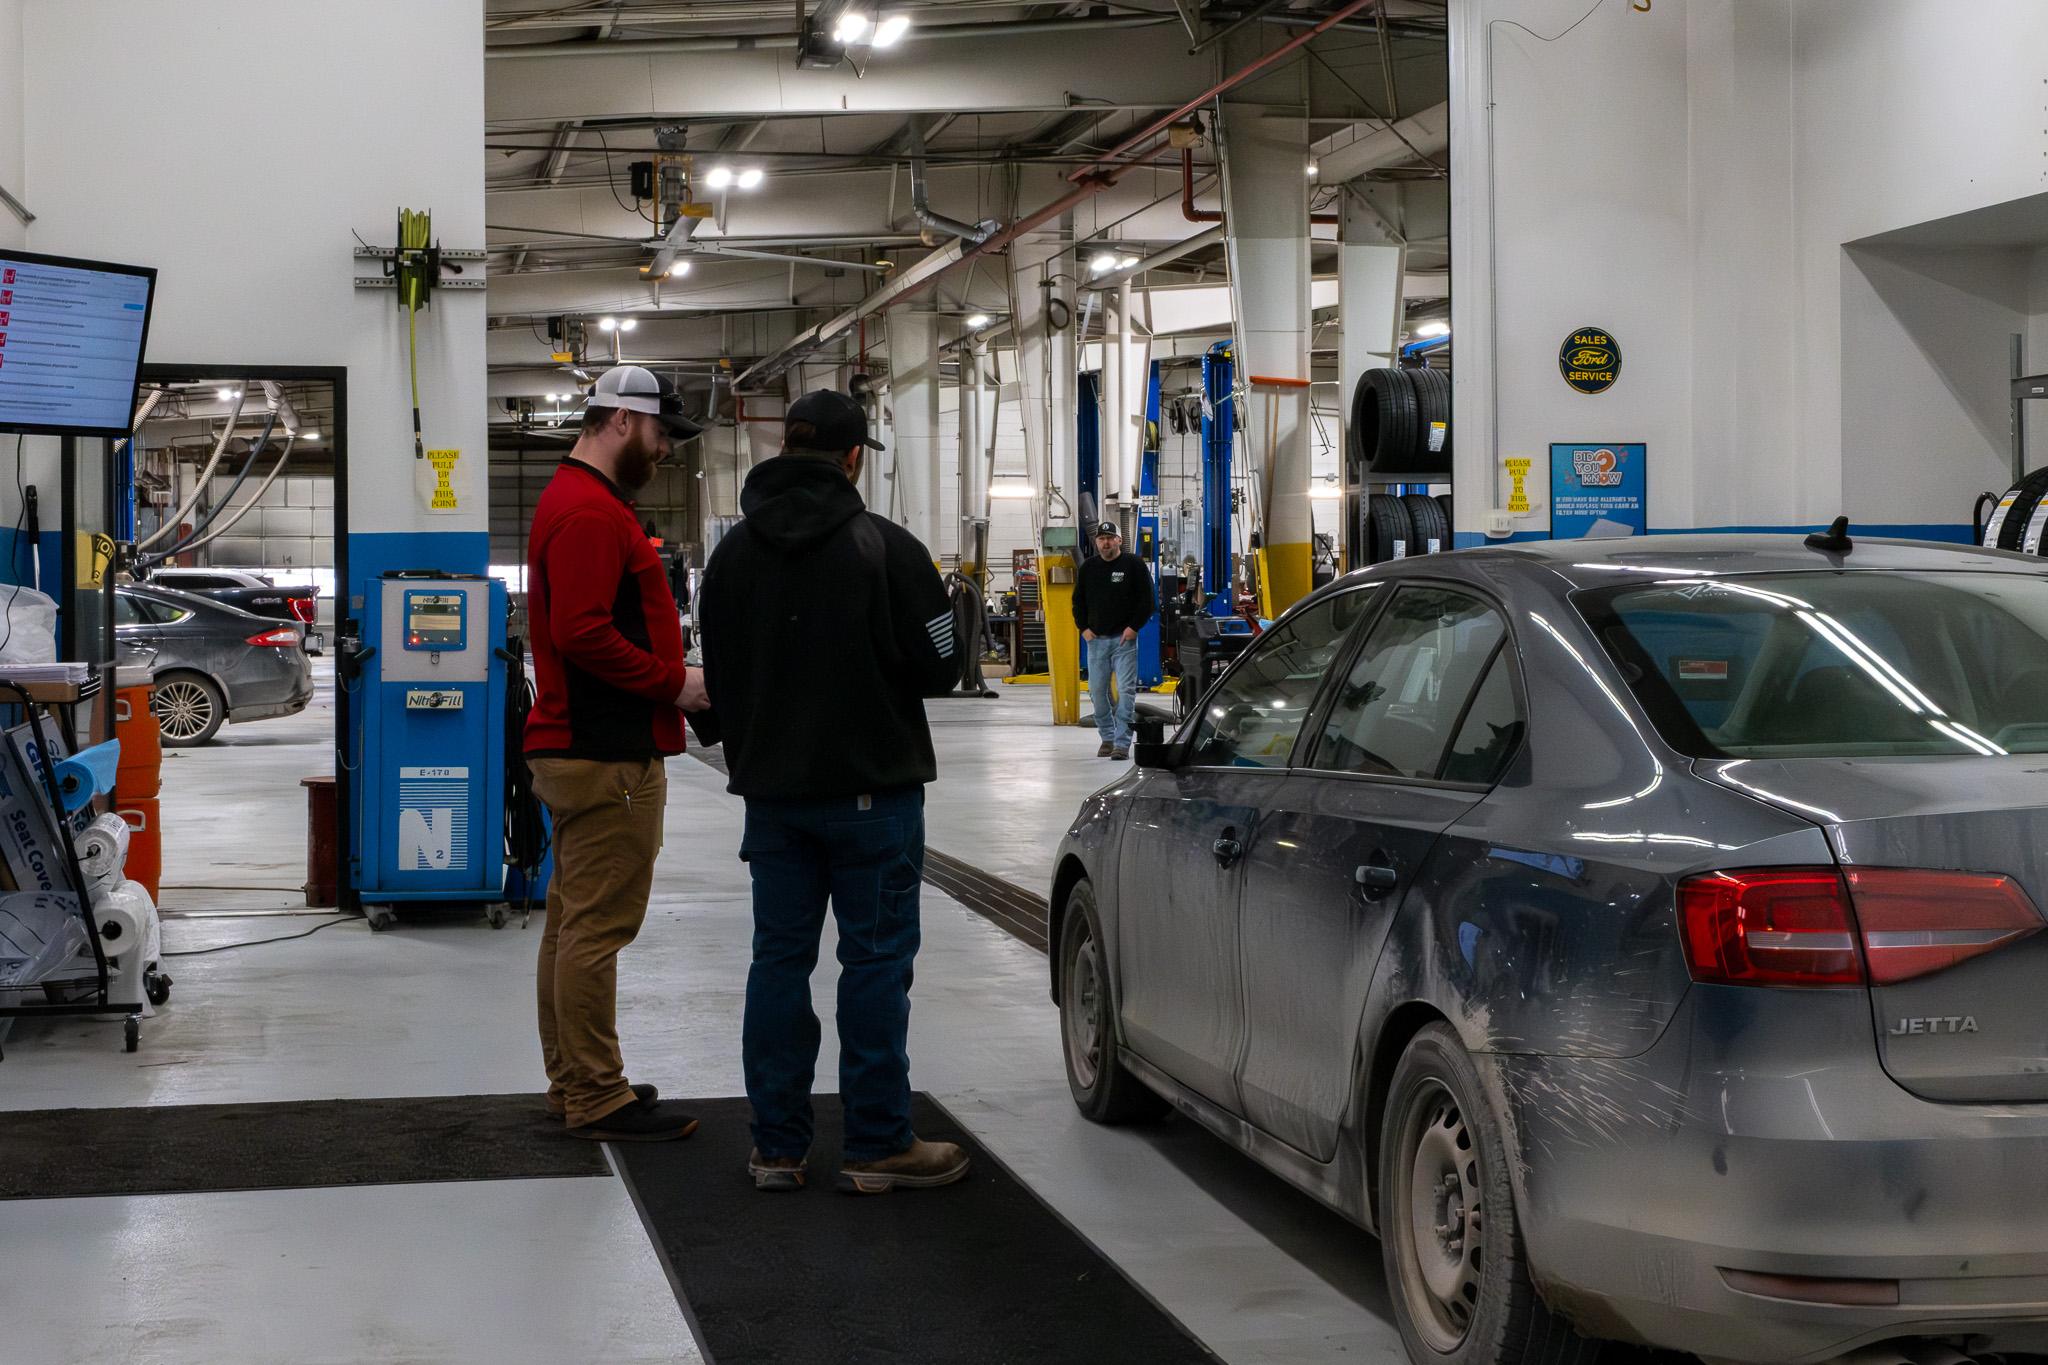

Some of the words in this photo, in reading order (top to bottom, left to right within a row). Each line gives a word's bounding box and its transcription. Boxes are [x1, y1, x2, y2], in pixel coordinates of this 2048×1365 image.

[1574, 336, 1607, 344] SALES
[1572, 350, 1609, 366] Ford
[1569, 372, 1612, 381] SERVICE
[427, 451, 459, 460] PLEASE
[1575, 452, 1594, 462] DID
[433, 461, 454, 469] PULL
[1575, 463, 1600, 473] YOU
[1583, 473, 1621, 484] KNOW
[439, 480, 450, 488] TO
[432, 499, 457, 508] POINT
[10, 809, 37, 850] Seat
[28, 849, 54, 893] Cove
[1889, 1015, 1979, 1035] JETTA
